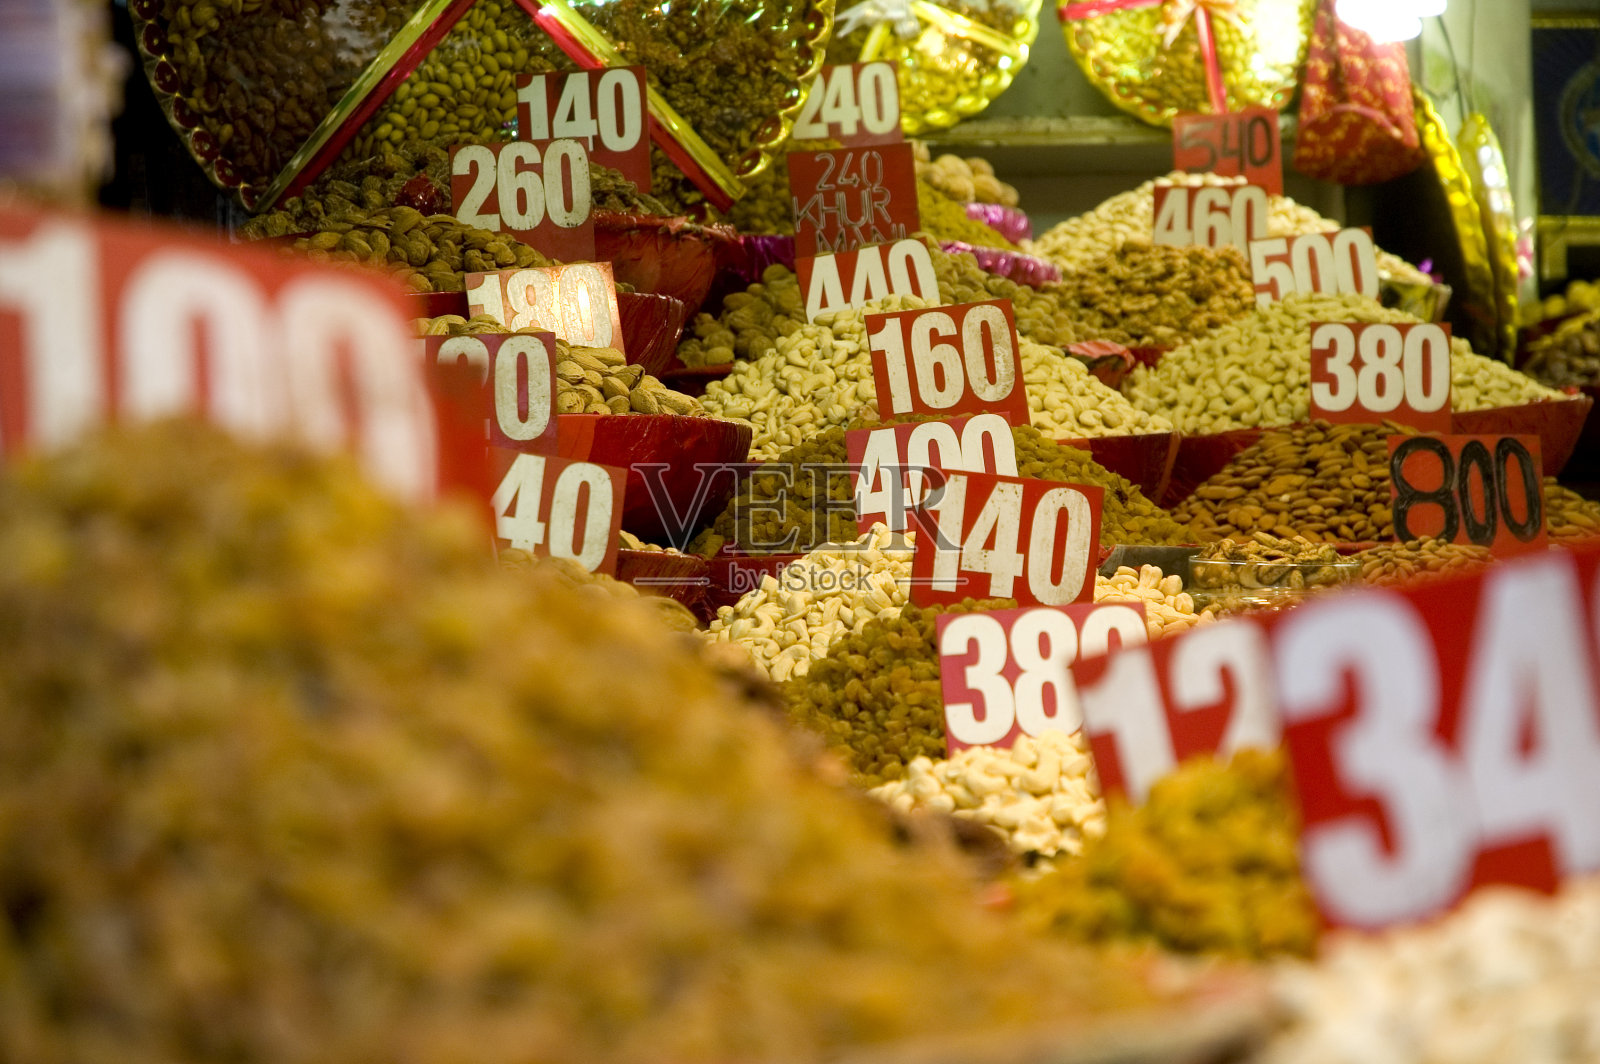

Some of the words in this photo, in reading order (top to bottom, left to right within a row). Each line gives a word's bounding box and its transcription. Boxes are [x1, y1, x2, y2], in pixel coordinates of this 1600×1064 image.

[517, 68, 643, 152] 140
[793, 62, 899, 139] 240
[451, 140, 592, 230] 260
[815, 151, 883, 190] 240
[1178, 117, 1274, 171] 540
[793, 187, 891, 233] KHUR
[1154, 186, 1267, 260] 460
[467, 262, 613, 348] 180
[806, 239, 940, 325] 440
[1251, 228, 1379, 309] 500
[868, 304, 1018, 414] 160
[1311, 323, 1449, 412] 380
[855, 413, 1018, 532] 400
[1390, 436, 1540, 545] 800
[931, 475, 1092, 606] 140
